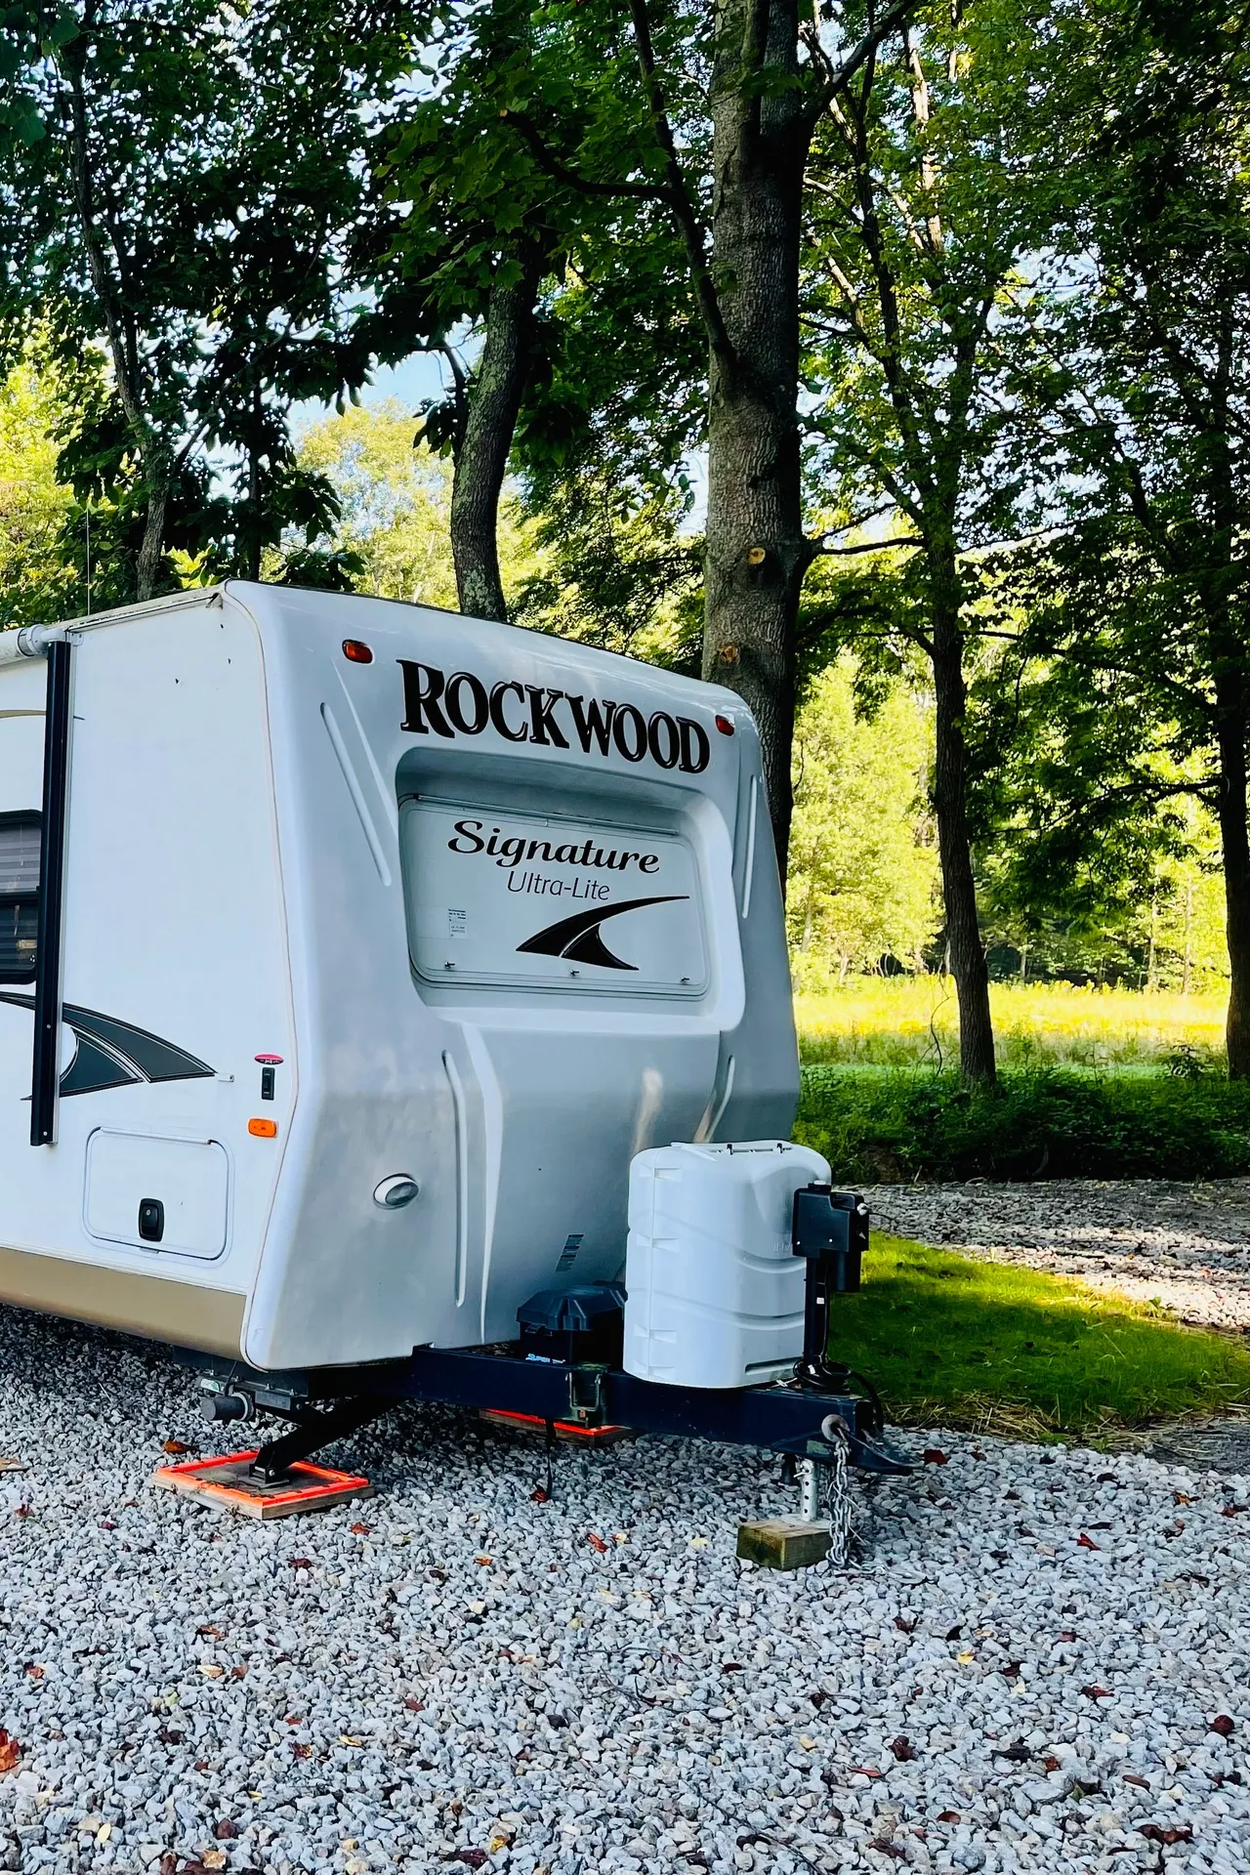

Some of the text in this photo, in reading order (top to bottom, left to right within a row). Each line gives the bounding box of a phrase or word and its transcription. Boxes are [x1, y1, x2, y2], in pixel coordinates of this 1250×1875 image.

[395, 658, 711, 775] ROCKWOOD
[447, 820, 661, 874] Signature
[506, 870, 611, 901] Ultra-Lite
